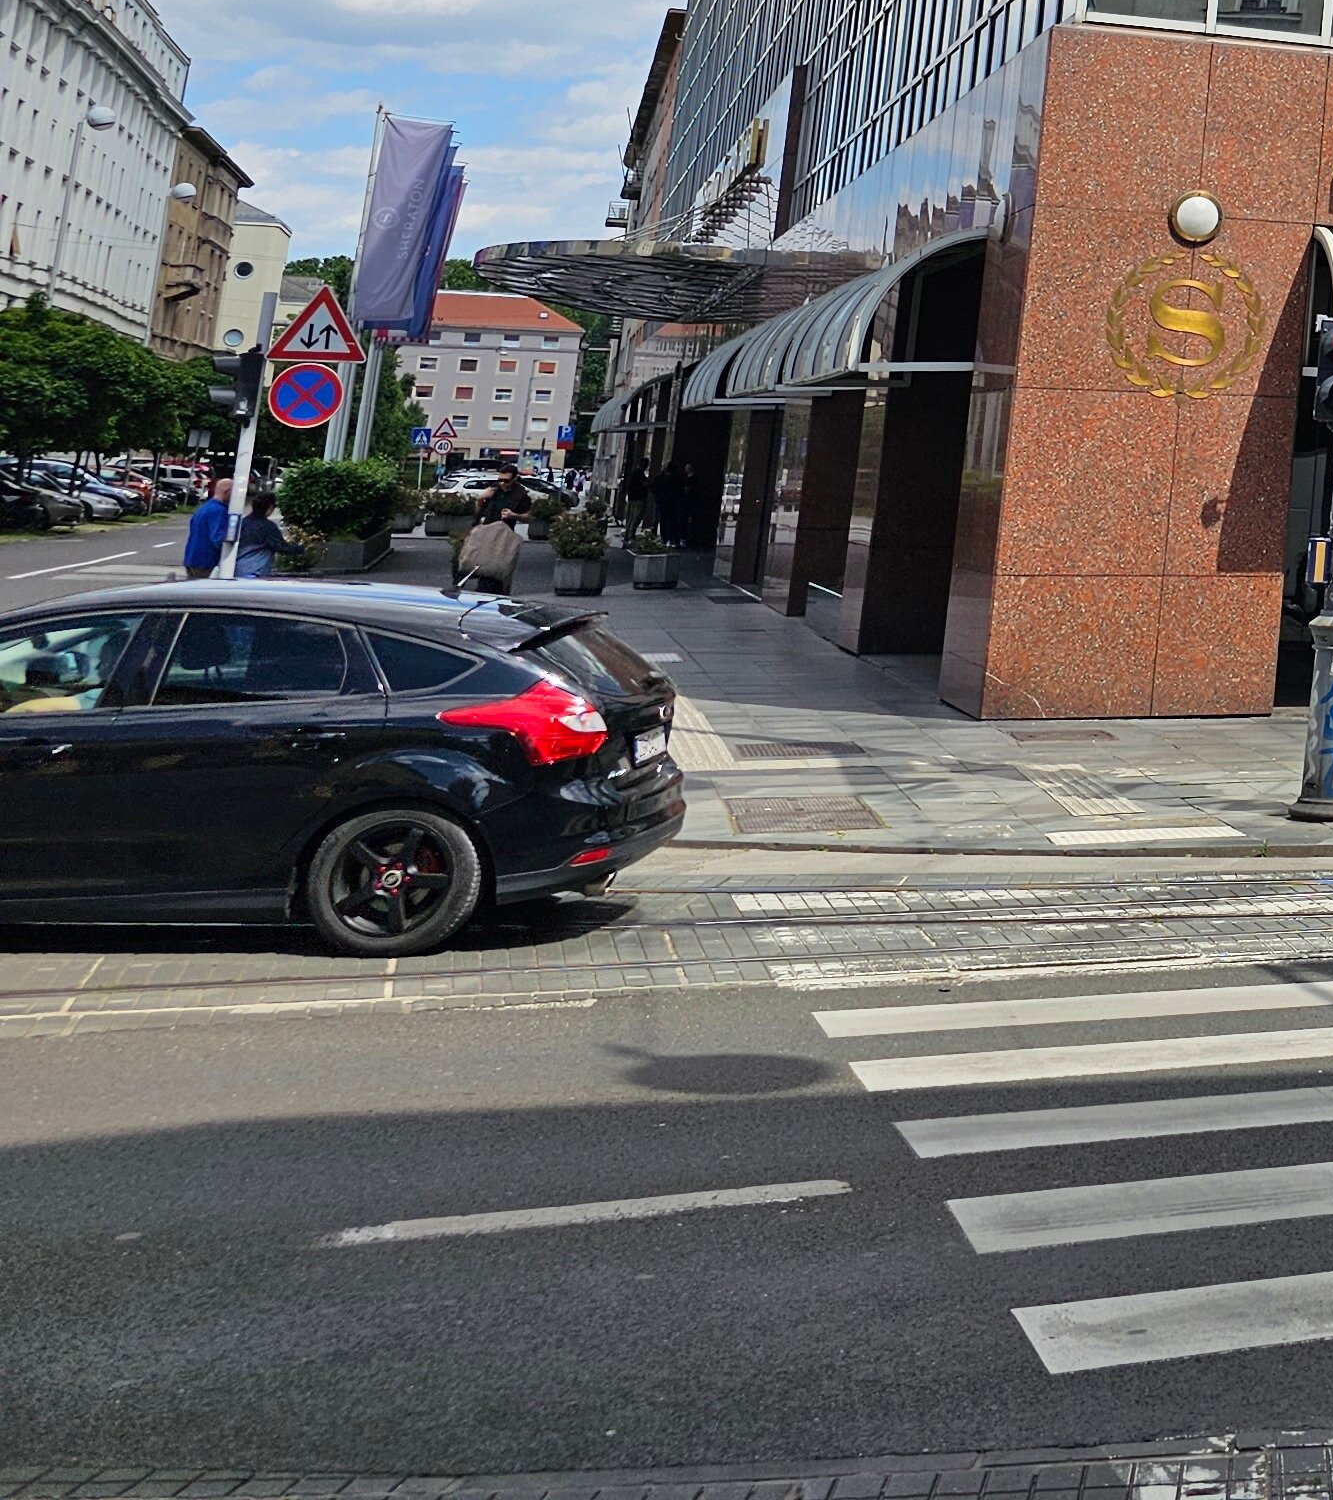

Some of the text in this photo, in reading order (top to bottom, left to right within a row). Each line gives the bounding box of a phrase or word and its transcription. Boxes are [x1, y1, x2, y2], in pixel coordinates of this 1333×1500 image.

[397, 178, 425, 260] SHERATON
[1148, 278, 1225, 367] S
[438, 442, 449, 451] 40
[561, 425, 572, 438] P
